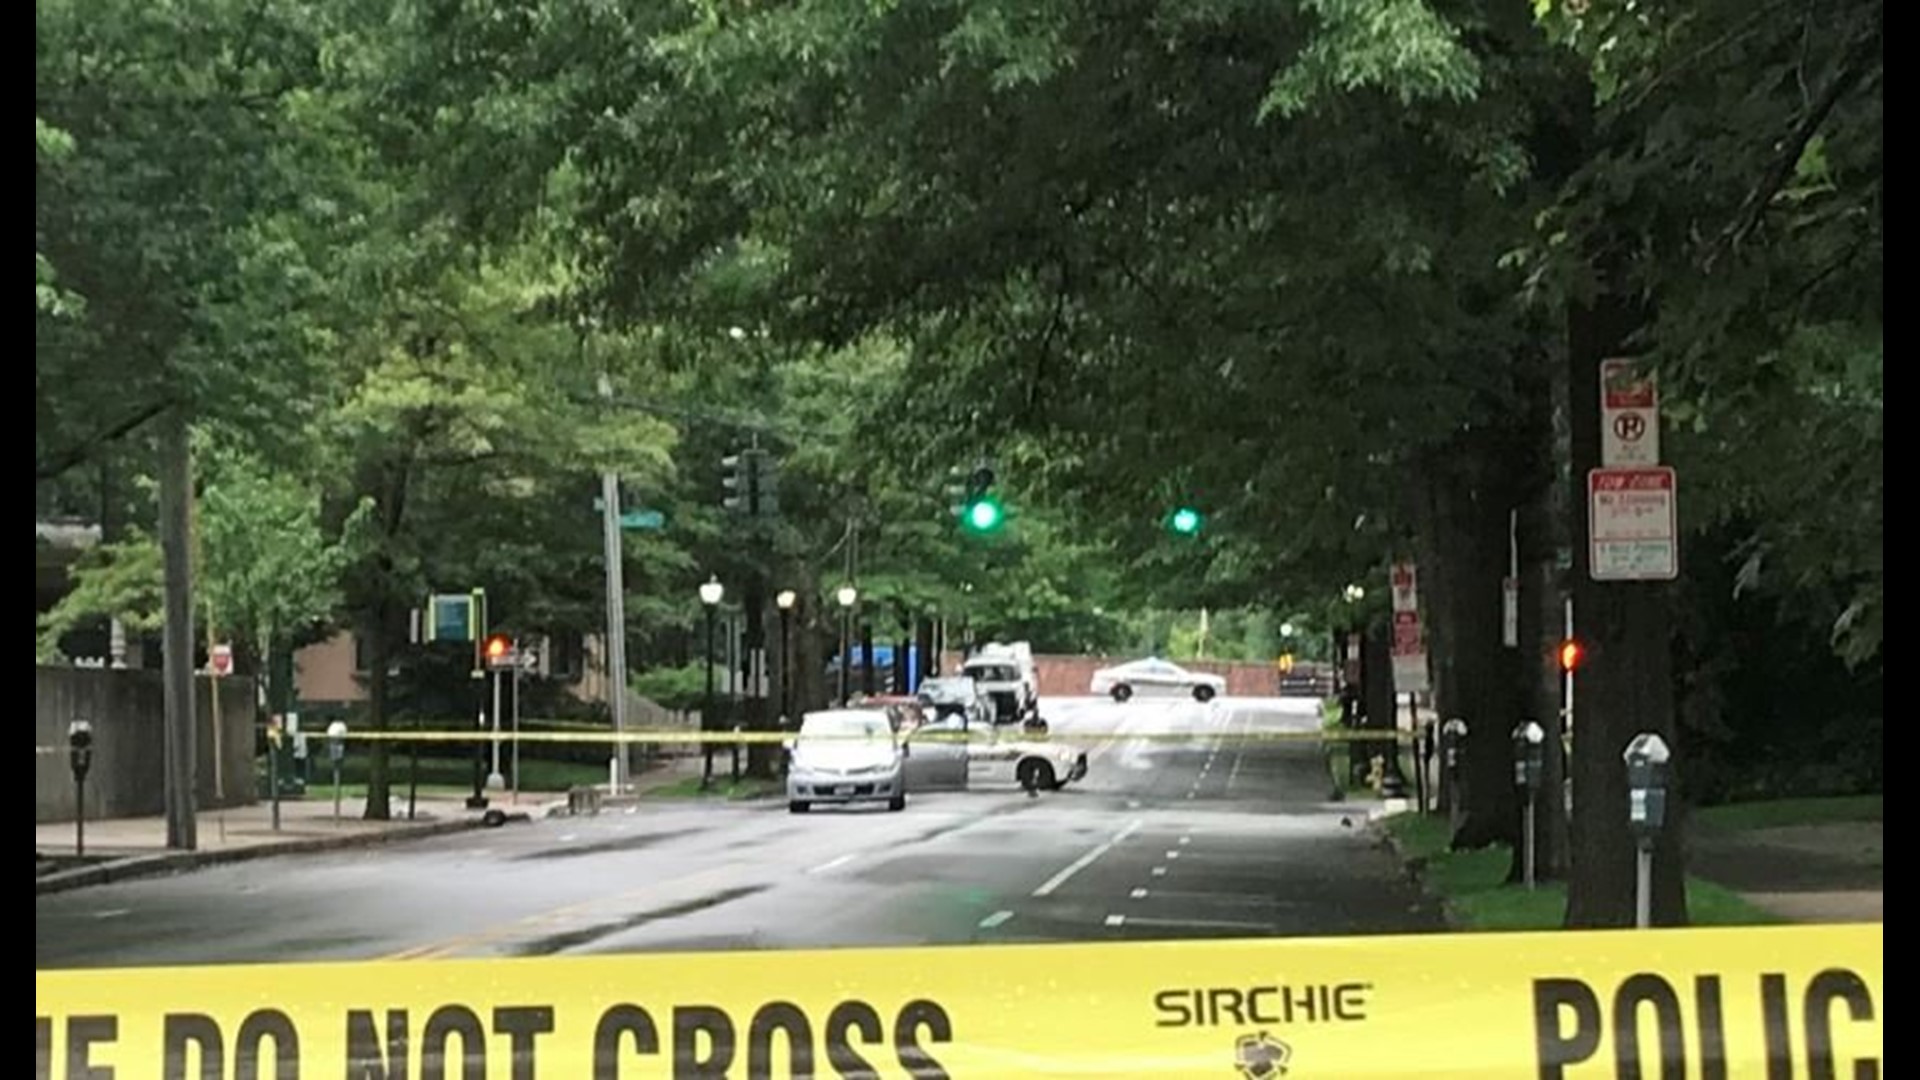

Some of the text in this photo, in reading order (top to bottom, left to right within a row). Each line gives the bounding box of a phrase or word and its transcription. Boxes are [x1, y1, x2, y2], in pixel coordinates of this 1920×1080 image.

[1154, 983, 1368, 1027] SIRCHIE
[346, 1003, 555, 1080] NOT
[592, 999, 953, 1080] CROSS
